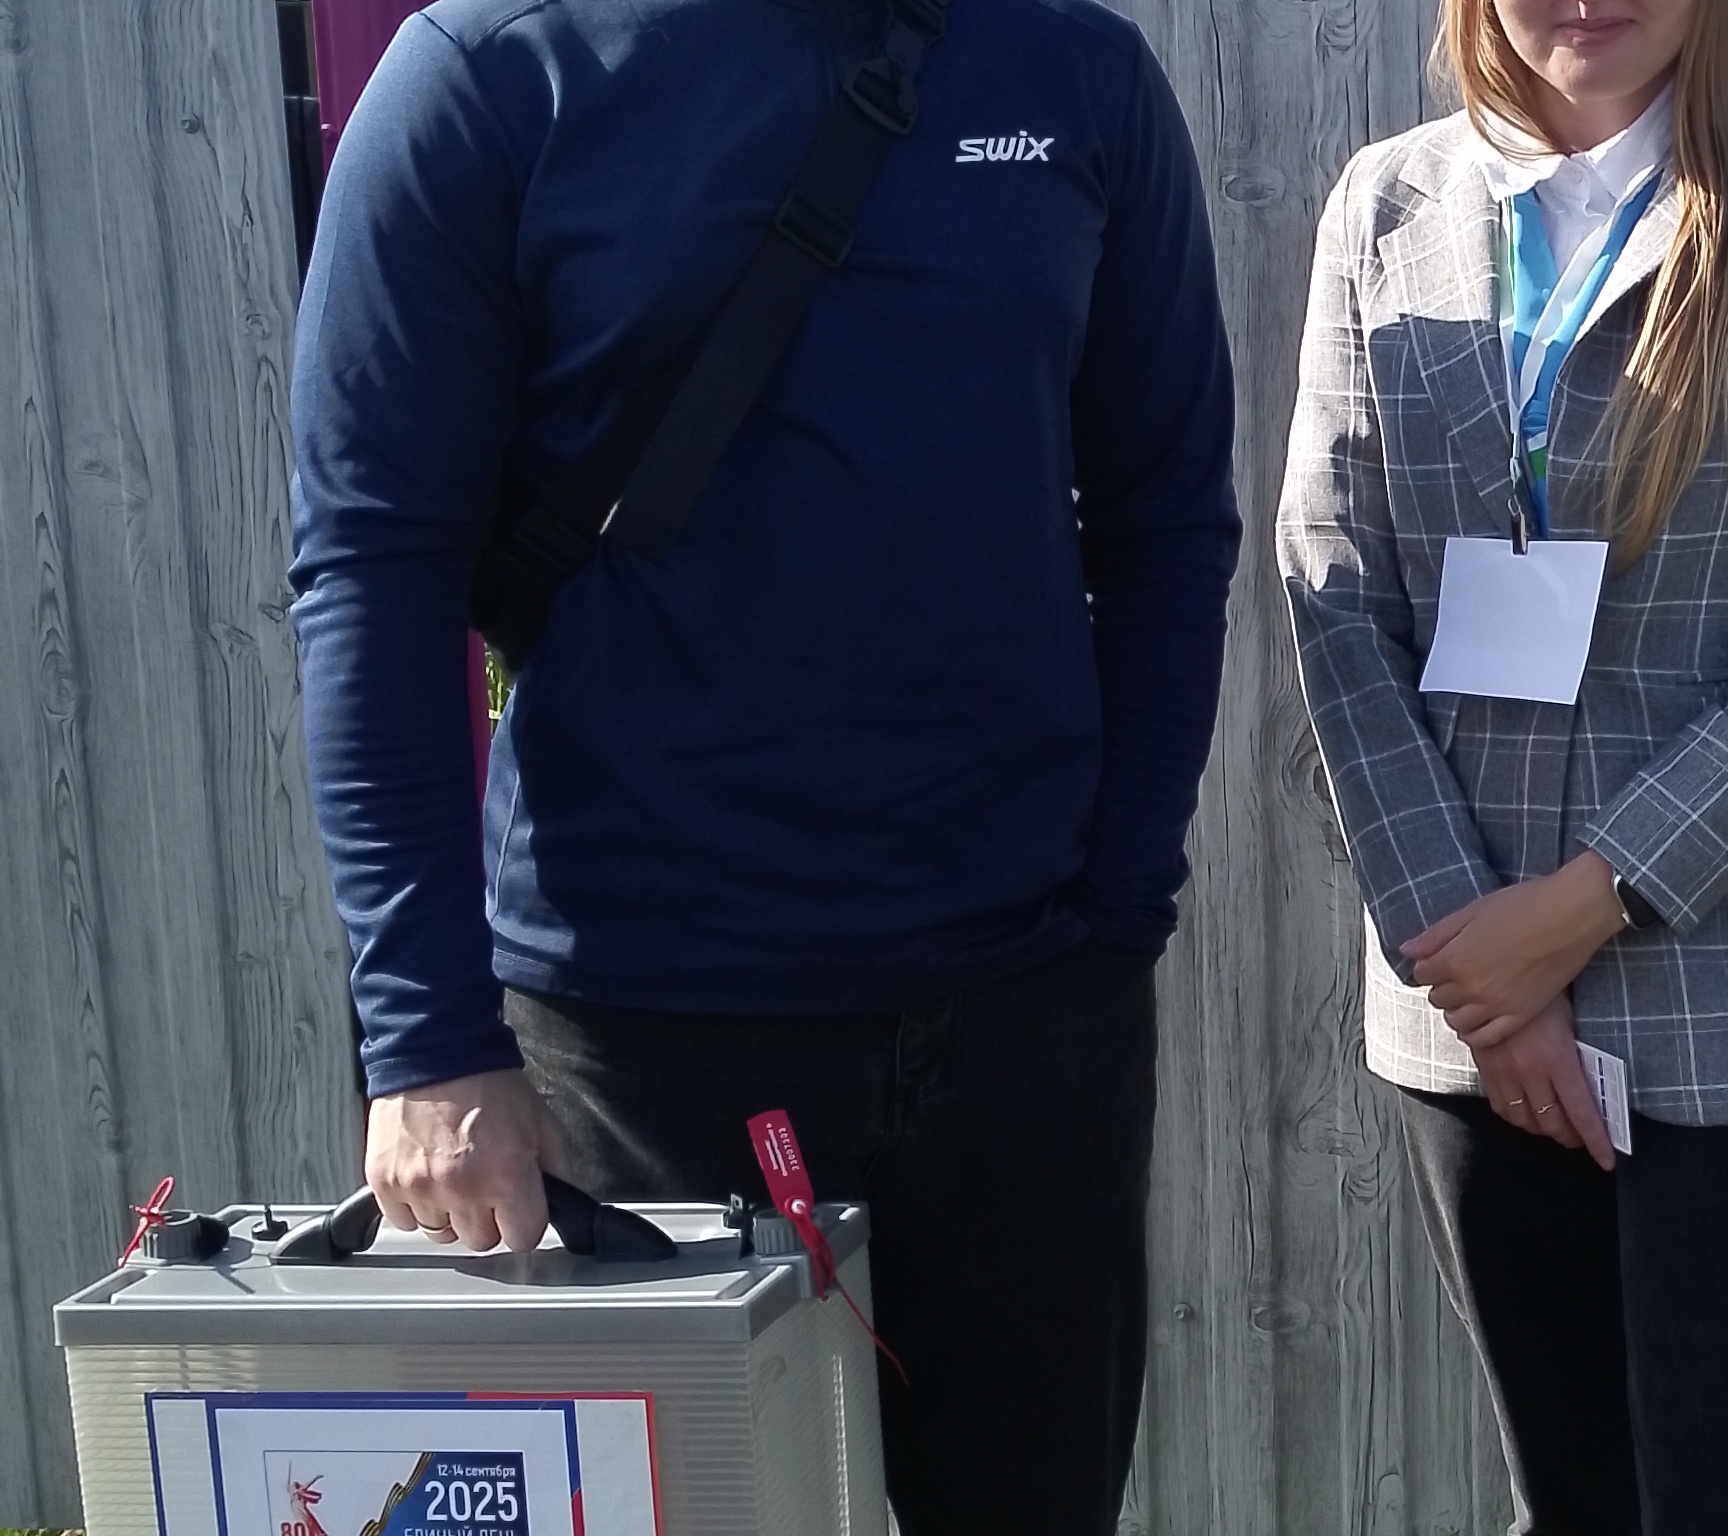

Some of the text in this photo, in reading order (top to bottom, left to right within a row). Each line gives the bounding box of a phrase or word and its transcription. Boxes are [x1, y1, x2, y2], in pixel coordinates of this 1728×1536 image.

[436, 1464, 516, 1479] 12-14 сентября
[424, 1480, 518, 1521] 2025
